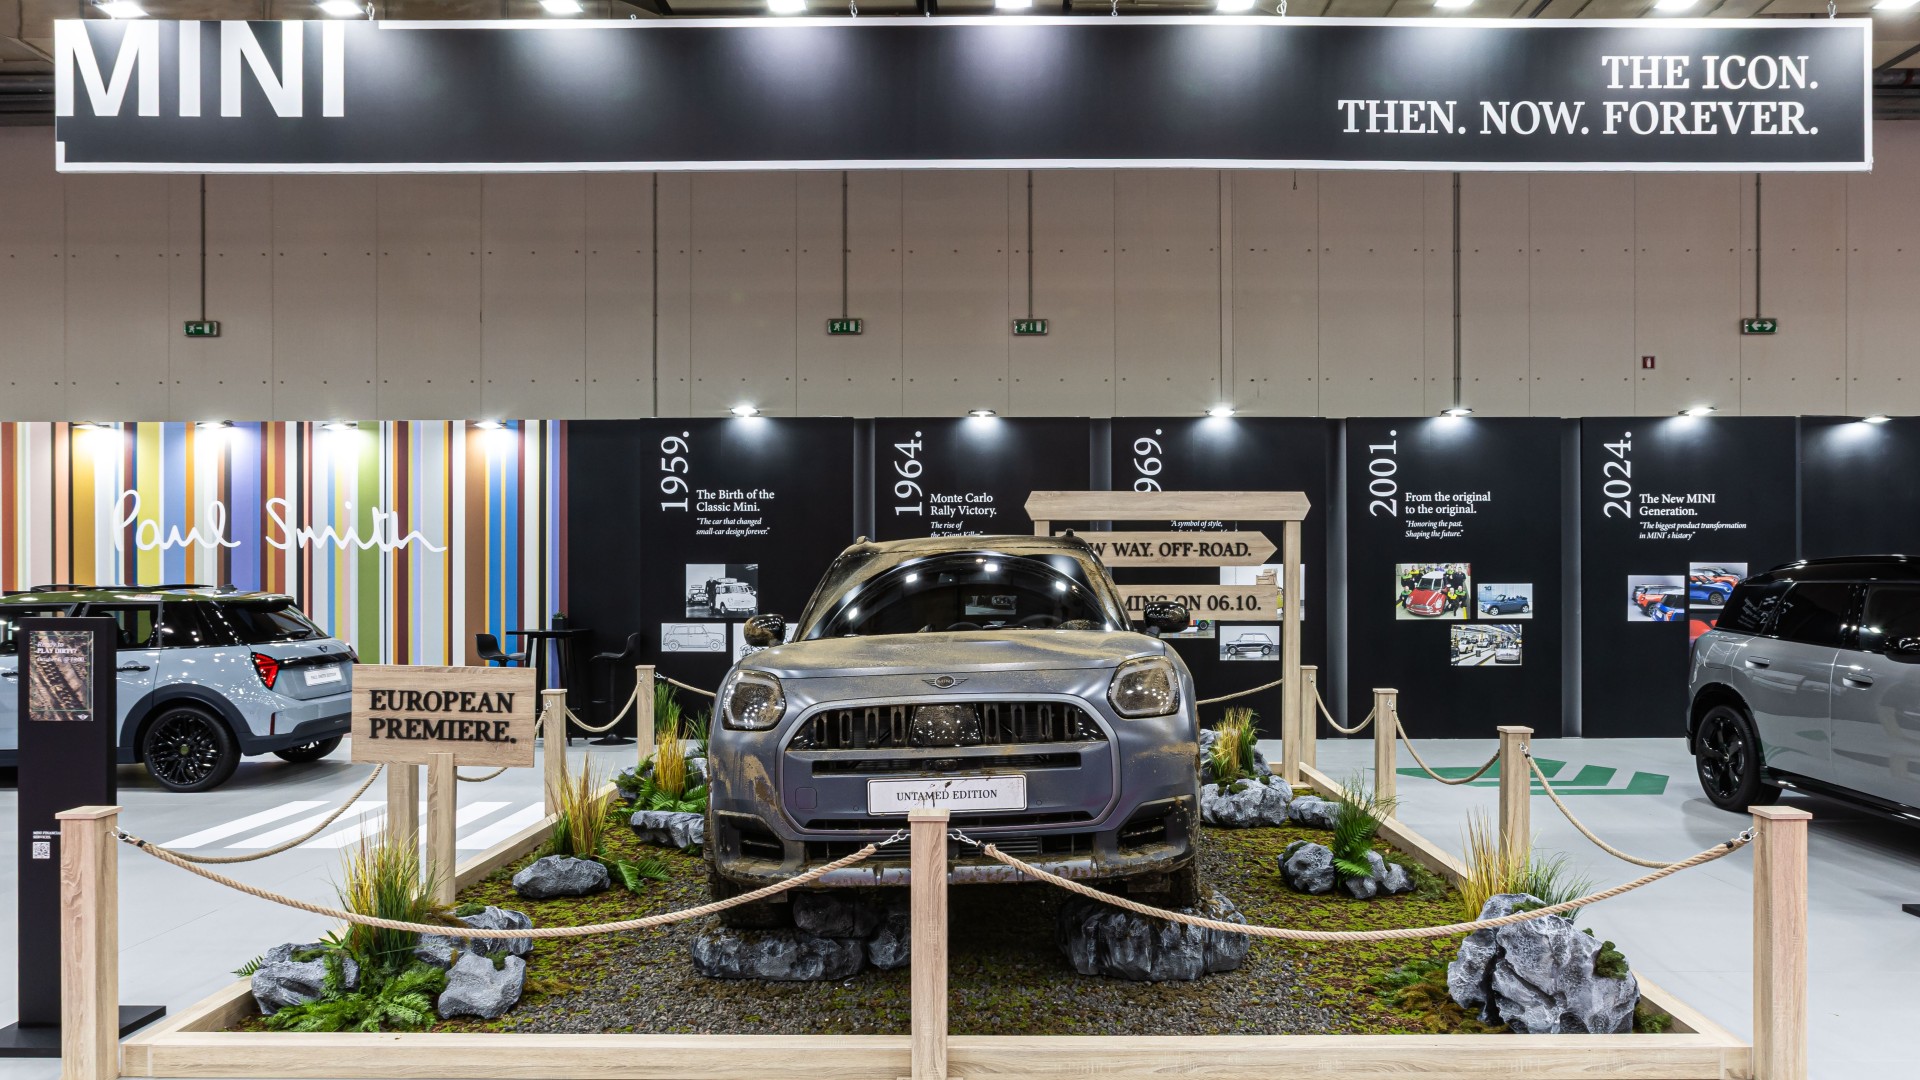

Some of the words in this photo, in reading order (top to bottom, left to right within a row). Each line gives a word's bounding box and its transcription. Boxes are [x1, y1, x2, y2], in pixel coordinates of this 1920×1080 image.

[56, 20, 345, 117] MINI
[1602, 55, 1690, 89] THE
[1702, 55, 1819, 90] ICON.
[1338, 100, 1466, 134] THEN.
[1480, 101, 1590, 135] NOW.
[1602, 101, 1819, 135] FOREVER.
[1134, 428, 1162, 491] 969.
[661, 431, 690, 512] 1959.
[894, 430, 923, 516] 1964.
[1369, 430, 1397, 517] 2001.
[1604, 431, 1632, 518] 2024.
[696, 489, 716, 500] The
[718, 489, 744, 500] Birth
[746, 489, 758, 500] of
[758, 489, 775, 500] the
[930, 493, 962, 503] Monte
[965, 492, 993, 503] Carlo
[1405, 492, 1432, 502] From
[1434, 491, 1450, 502] the
[1452, 491, 1491, 504] original
[1639, 493, 1660, 503] The
[1661, 493, 1685, 503] New
[1687, 493, 1716, 504] MINI
[696, 501, 731, 512] Classic
[733, 501, 760, 512] Mini.
[930, 505, 956, 518] Rally
[958, 505, 997, 518] Victory.
[1405, 505, 1416, 514] to
[1417, 503, 1434, 514] the
[1435, 503, 1477, 517] original.
[1639, 506, 1698, 516] Generation.
[113, 489, 241, 551] Paul
[265, 497, 447, 552] Smith
[736, 518, 763, 527] changed
[931, 521, 943, 529] The
[943, 521, 956, 529] rise
[955, 520, 964, 531] of
[1178, 520, 1200, 528] symbol
[1200, 520, 1208, 529] of
[1448, 521, 1463, 529] past.
[1655, 521, 1676, 531] biggest
[1676, 521, 1700, 531] product
[1701, 521, 1747, 531] transformation
[696, 527, 725, 535] small-car
[725, 527, 745, 537] design
[1405, 530, 1431, 539] Shaping
[1111, 542, 1154, 557] WAY.
[1158, 541, 1252, 558] OFF-ROAD.
[1207, 594, 1262, 611] 06.10.
[369, 689, 516, 714] EUROPEAN
[369, 717, 517, 744] PREMIERE.
[896, 790, 950, 801] UNTAMED
[952, 789, 998, 800] EDITION
